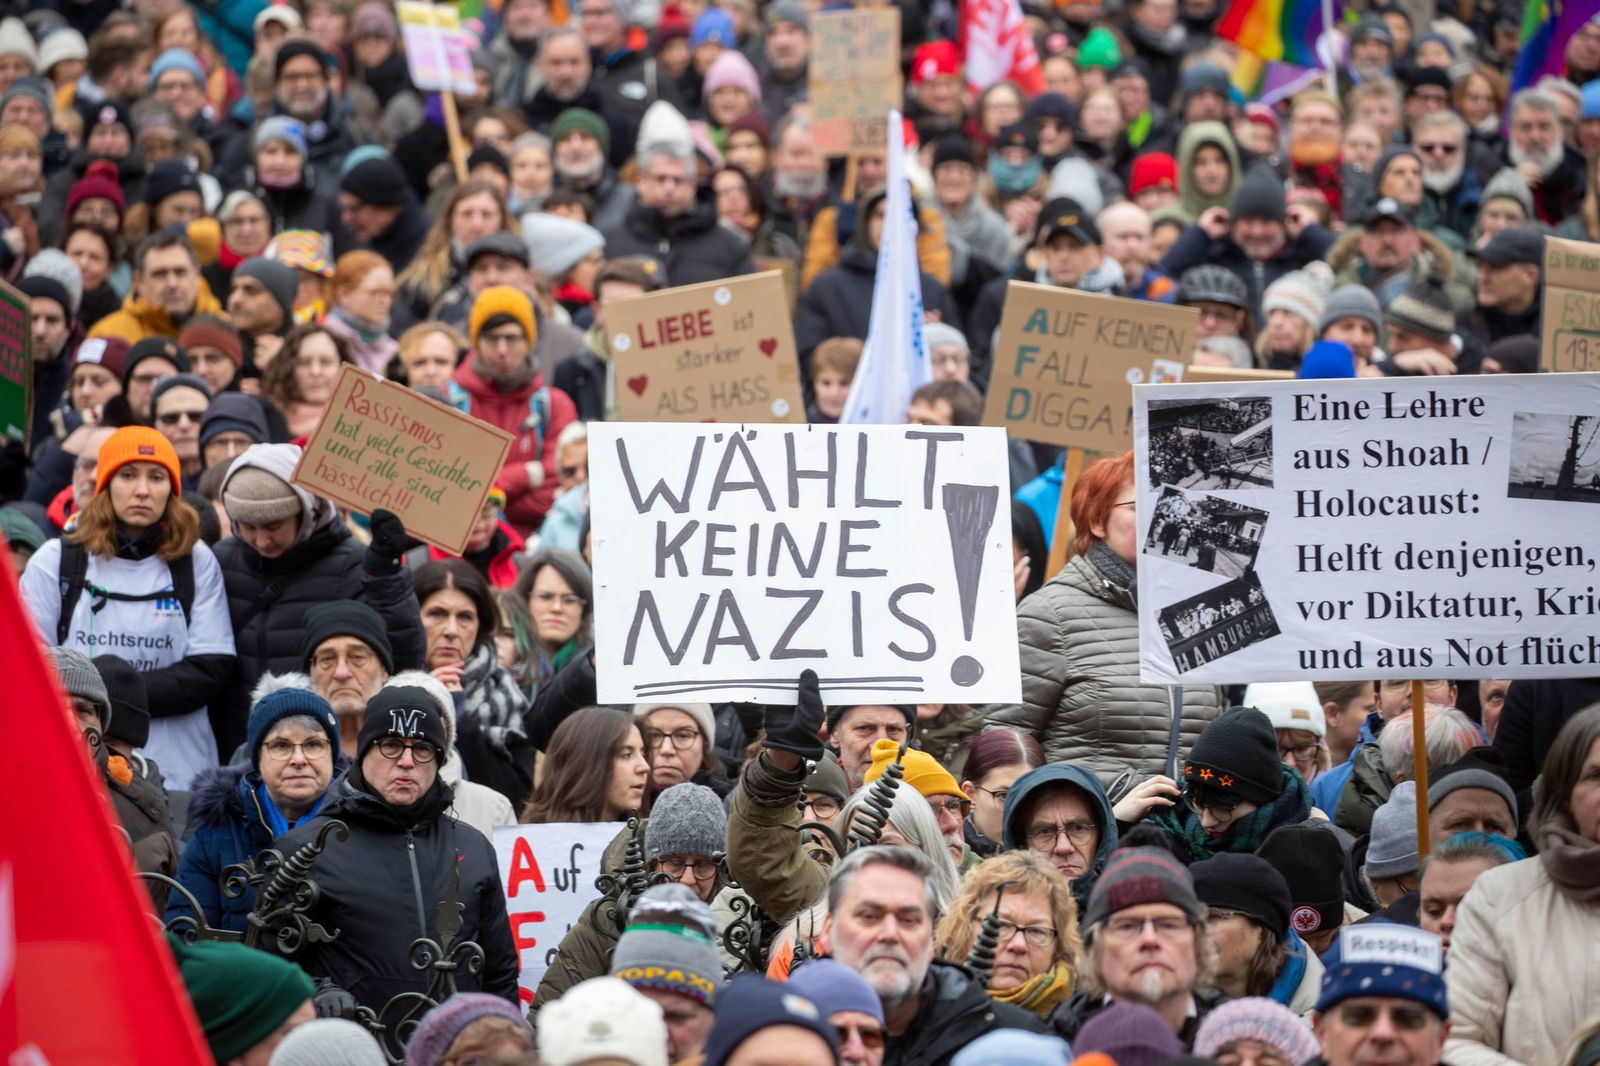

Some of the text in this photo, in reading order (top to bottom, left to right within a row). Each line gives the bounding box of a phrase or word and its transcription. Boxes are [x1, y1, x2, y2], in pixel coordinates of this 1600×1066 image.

[637, 308, 754, 350] LIEBE ist
[1023, 308, 1186, 355] AUF KEINEN
[1014, 345, 1093, 389] FALL
[344, 378, 444, 450] Rassismus
[655, 375, 770, 416] ALS HASS
[1292, 390, 1486, 422] Eine Lehre
[325, 438, 448, 505] und alle sind
[333, 413, 483, 492] hat viele Gesichter
[615, 430, 964, 514] WÄHLT
[1293, 436, 1493, 470] aus Shoah /
[1294, 488, 1480, 518] Holocaust:
[655, 519, 888, 578] KEINE
[1295, 539, 1596, 577] Helft denjenigen,
[1295, 586, 1600, 623] vor Diktatur, Kri
[76, 630, 174, 650] Rechtsruck
[1297, 641, 1364, 669] und
[1376, 646, 1433, 668] aus
[1445, 637, 1509, 667] Not
[388, 708, 427, 738] M
